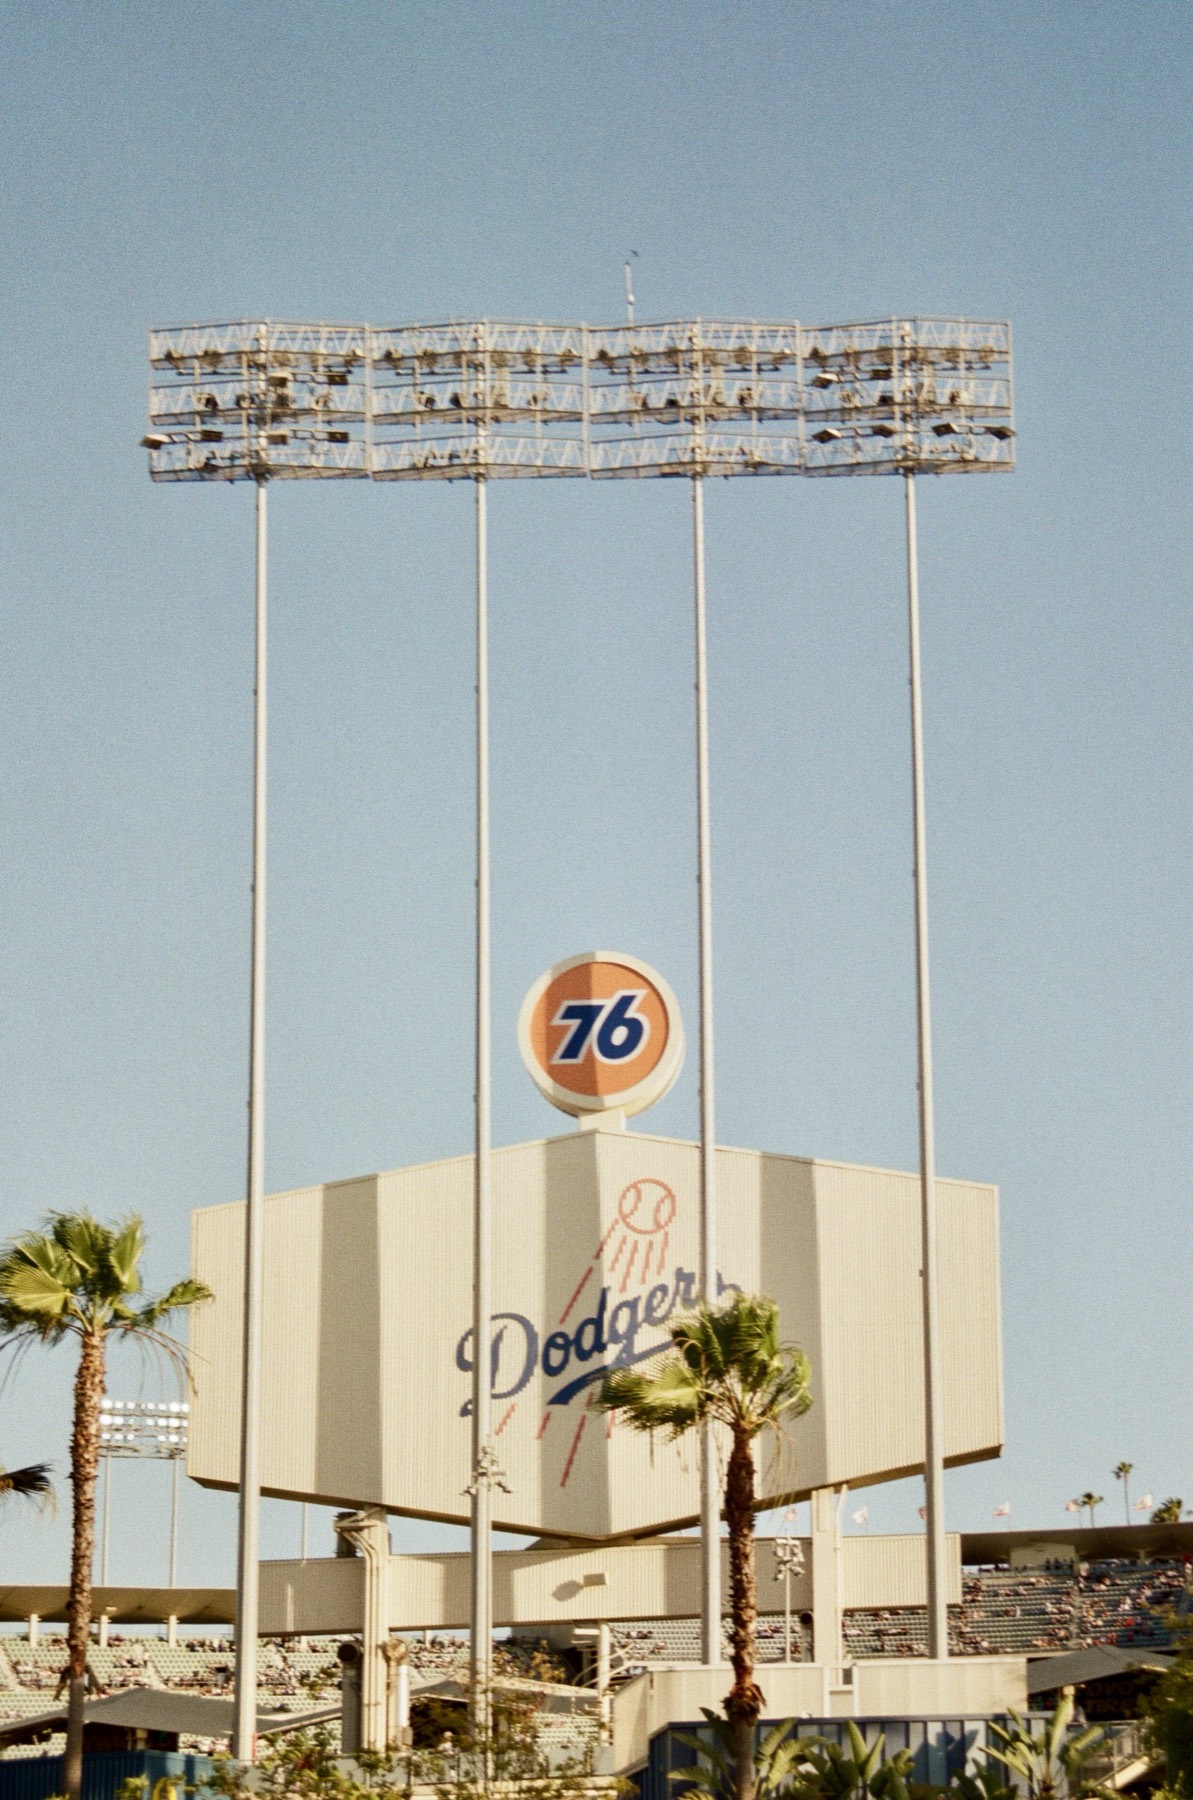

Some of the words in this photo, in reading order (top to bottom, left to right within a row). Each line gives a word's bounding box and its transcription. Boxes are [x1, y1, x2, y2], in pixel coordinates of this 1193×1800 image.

[551, 989, 650, 1065] 76
[1084, 1682, 1133, 1697] OYO
[1084, 1698, 1137, 1713] TIRE
